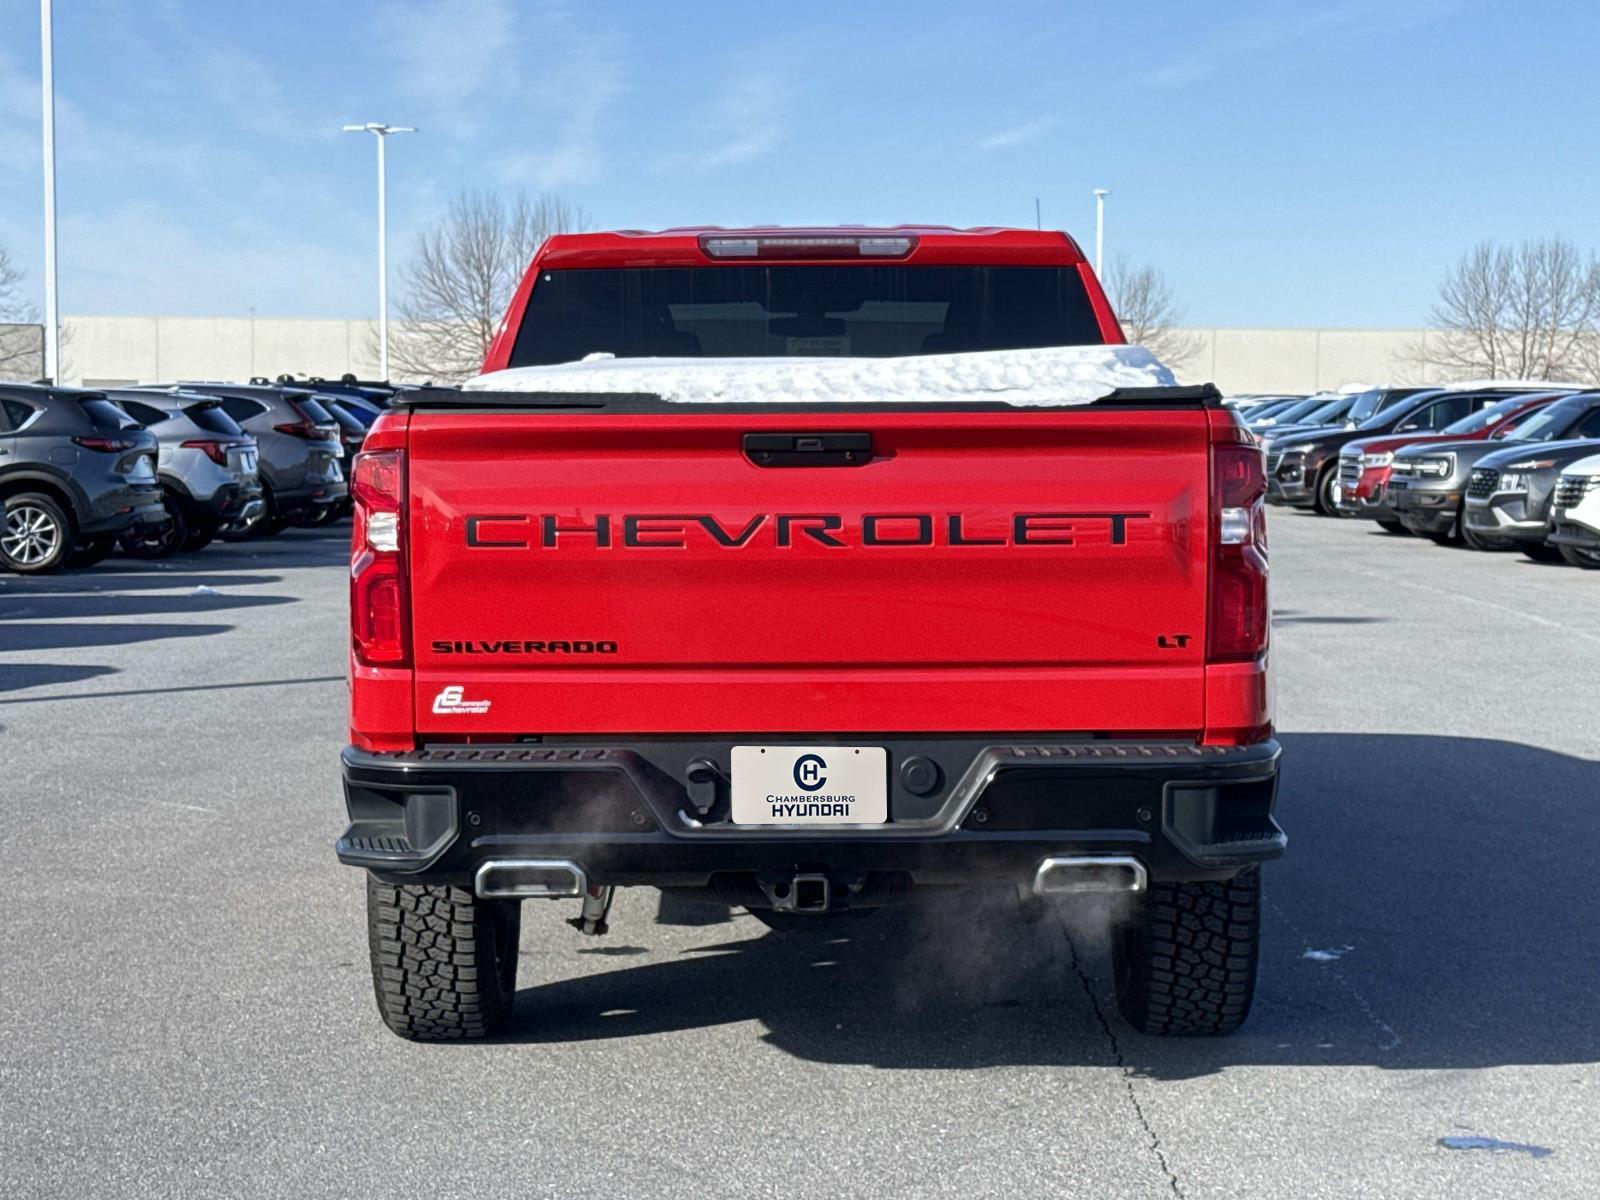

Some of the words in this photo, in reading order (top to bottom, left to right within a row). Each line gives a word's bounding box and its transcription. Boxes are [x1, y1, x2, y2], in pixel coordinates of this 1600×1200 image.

[465, 512, 1150, 548] CHEVROLET
[432, 640, 618, 653] SILVERADO
[1157, 634, 1192, 648] LT
[766, 794, 856, 803] CHAMBERSBURG
[772, 804, 849, 817] HYUNDAI
